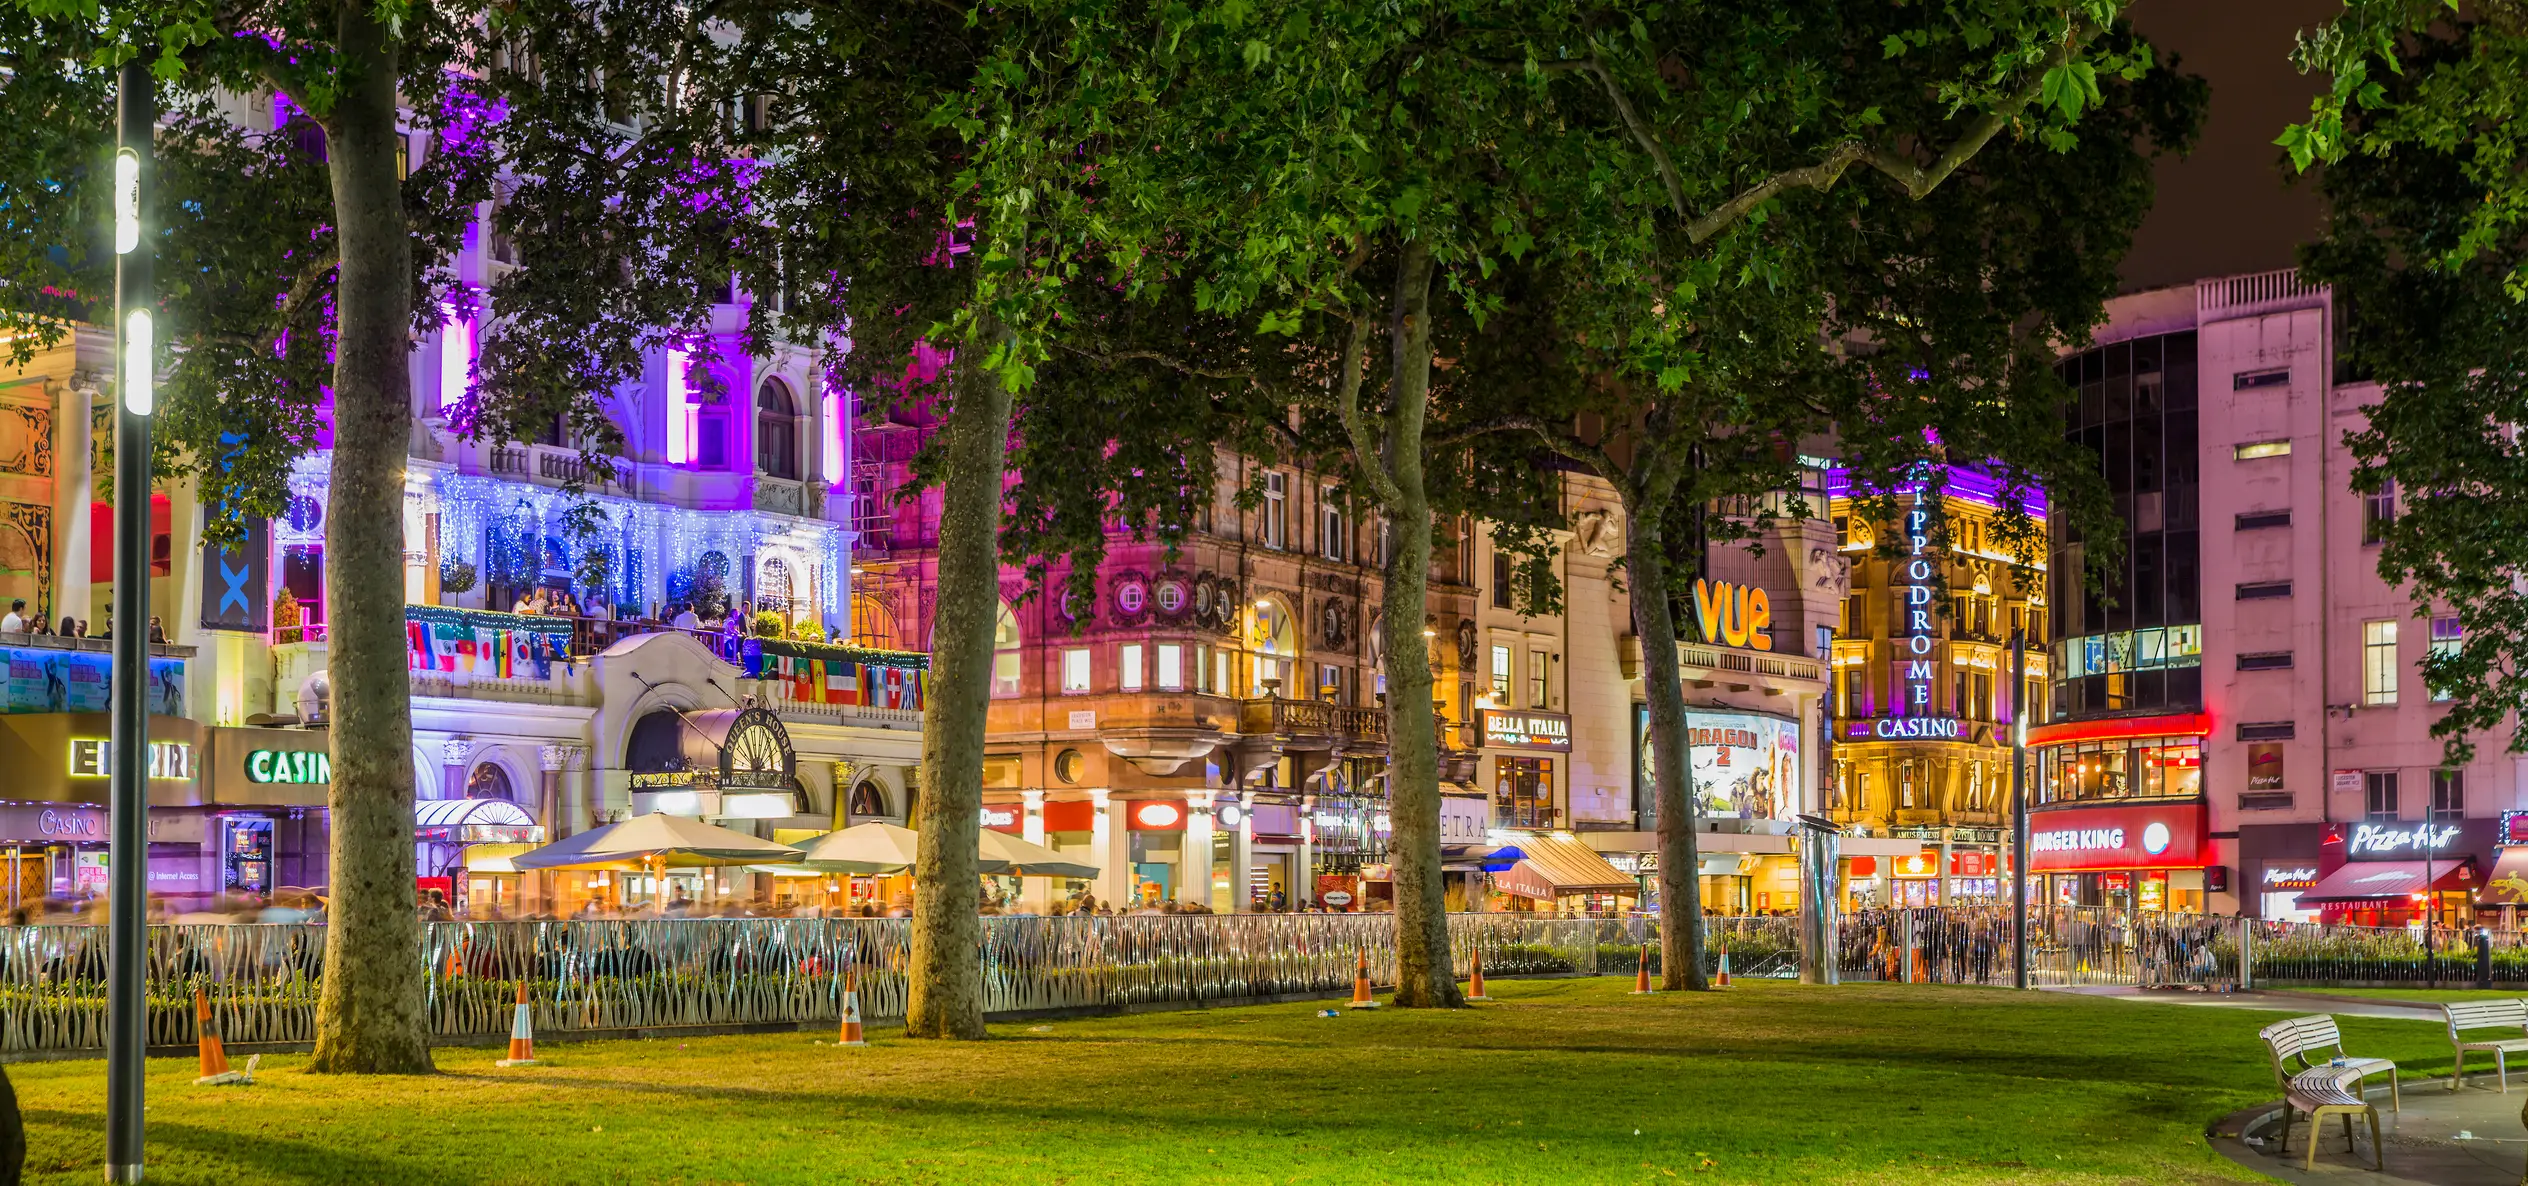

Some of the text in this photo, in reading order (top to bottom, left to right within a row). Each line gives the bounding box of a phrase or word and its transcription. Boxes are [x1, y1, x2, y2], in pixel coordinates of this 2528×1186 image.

[726, 711, 792, 756] QUEEN'S HOUSE
[1487, 715, 1568, 737] BELLA ITALIA
[1877, 717, 1958, 738] CASINO
[1688, 727, 1758, 751] DRAGON
[250, 749, 331, 784] CASIN
[1716, 746, 1731, 767] 2
[2250, 776, 2281, 785] Pizza Hut
[1441, 815, 1487, 838] ETRA
[1896, 830, 1940, 840] AMUSEMENTS
[2033, 830, 2079, 852] BURGER
[2080, 828, 2123, 850] KING
[2350, 823, 2462, 854] Pizza Hut
[156, 871, 178, 880] Internet
[179, 871, 199, 880] Access
[2263, 868, 2293, 884] Pizza
[2274, 880, 2318, 888] EXPRESS
[1516, 883, 1547, 897] ITALIA
[2320, 899, 2389, 911] RESTAURANT
